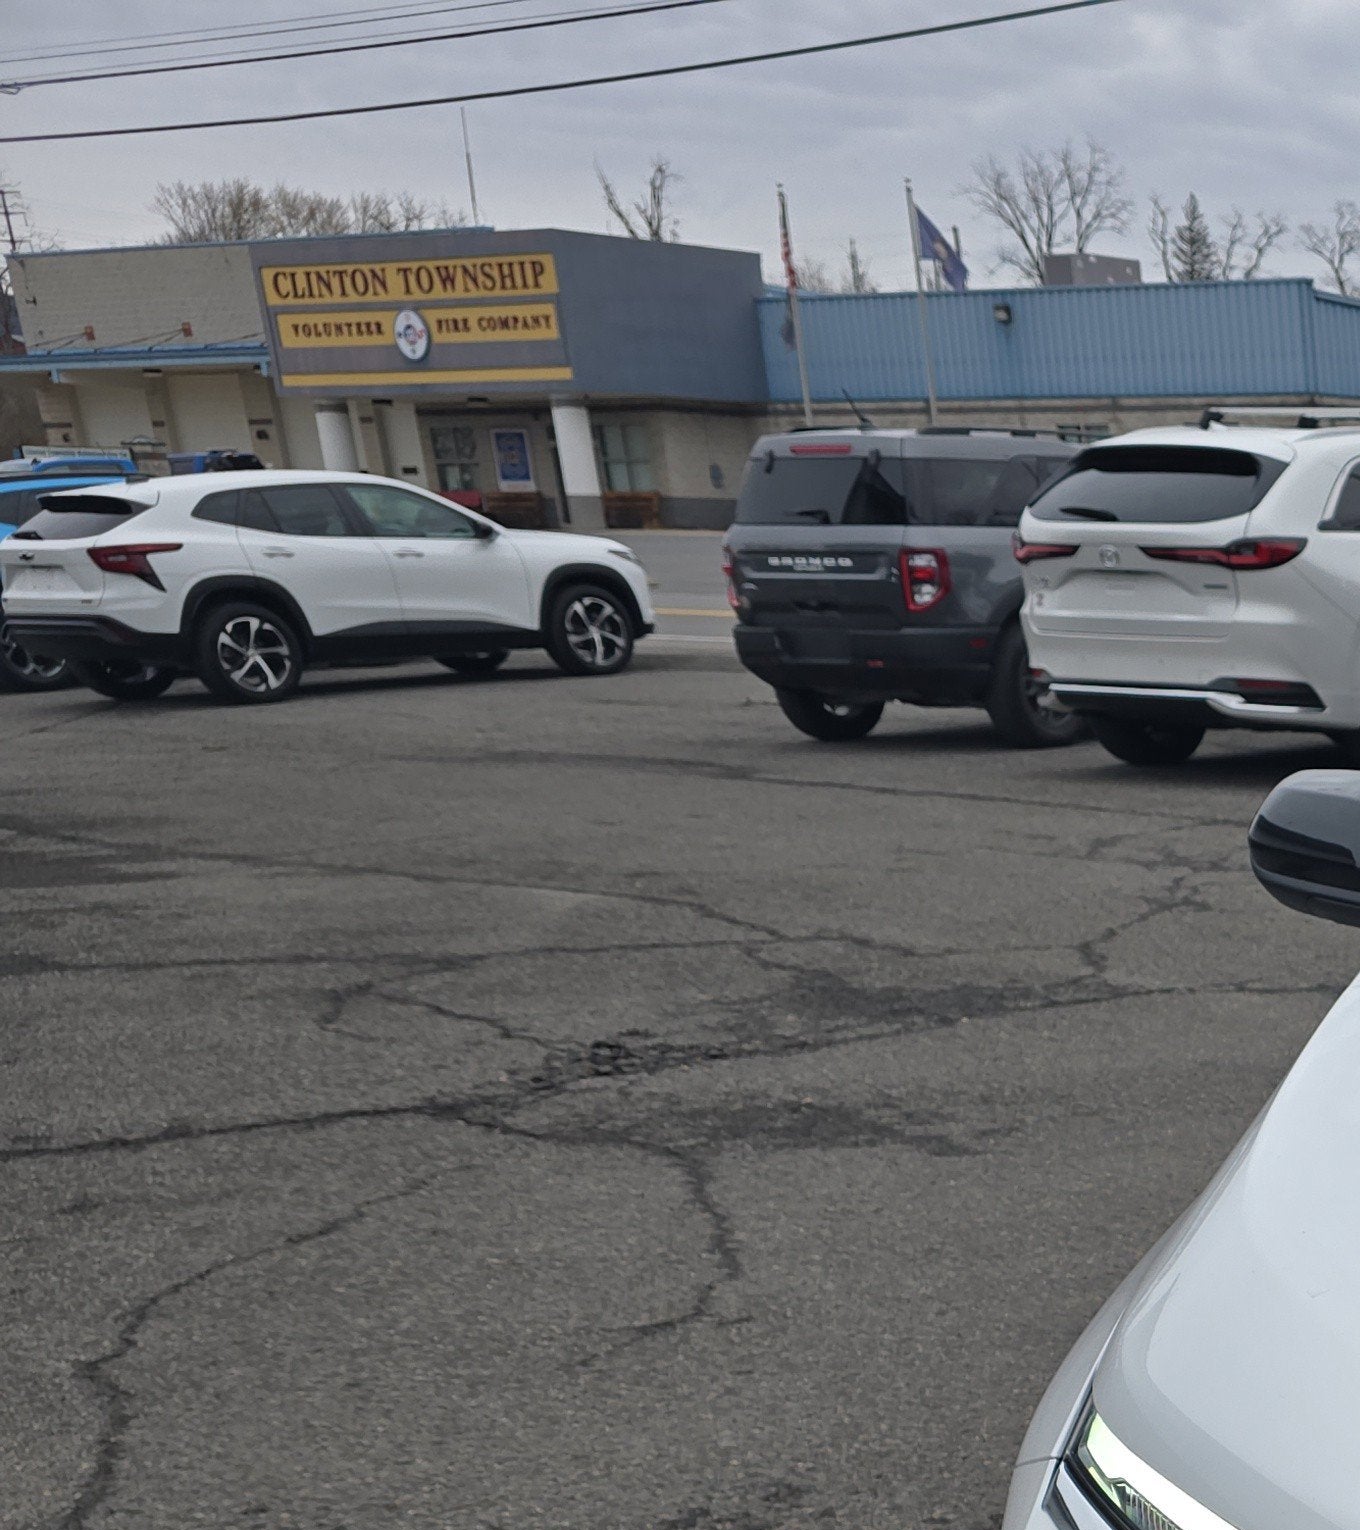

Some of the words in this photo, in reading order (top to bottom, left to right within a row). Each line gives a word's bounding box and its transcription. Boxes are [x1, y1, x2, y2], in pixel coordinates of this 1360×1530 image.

[272, 267, 389, 299] CLINTON
[397, 260, 545, 295] TOWNSHIP
[291, 321, 385, 338] VOLUNTEER
[436, 318, 470, 334] FIRE
[477, 314, 552, 332] COMPANY
